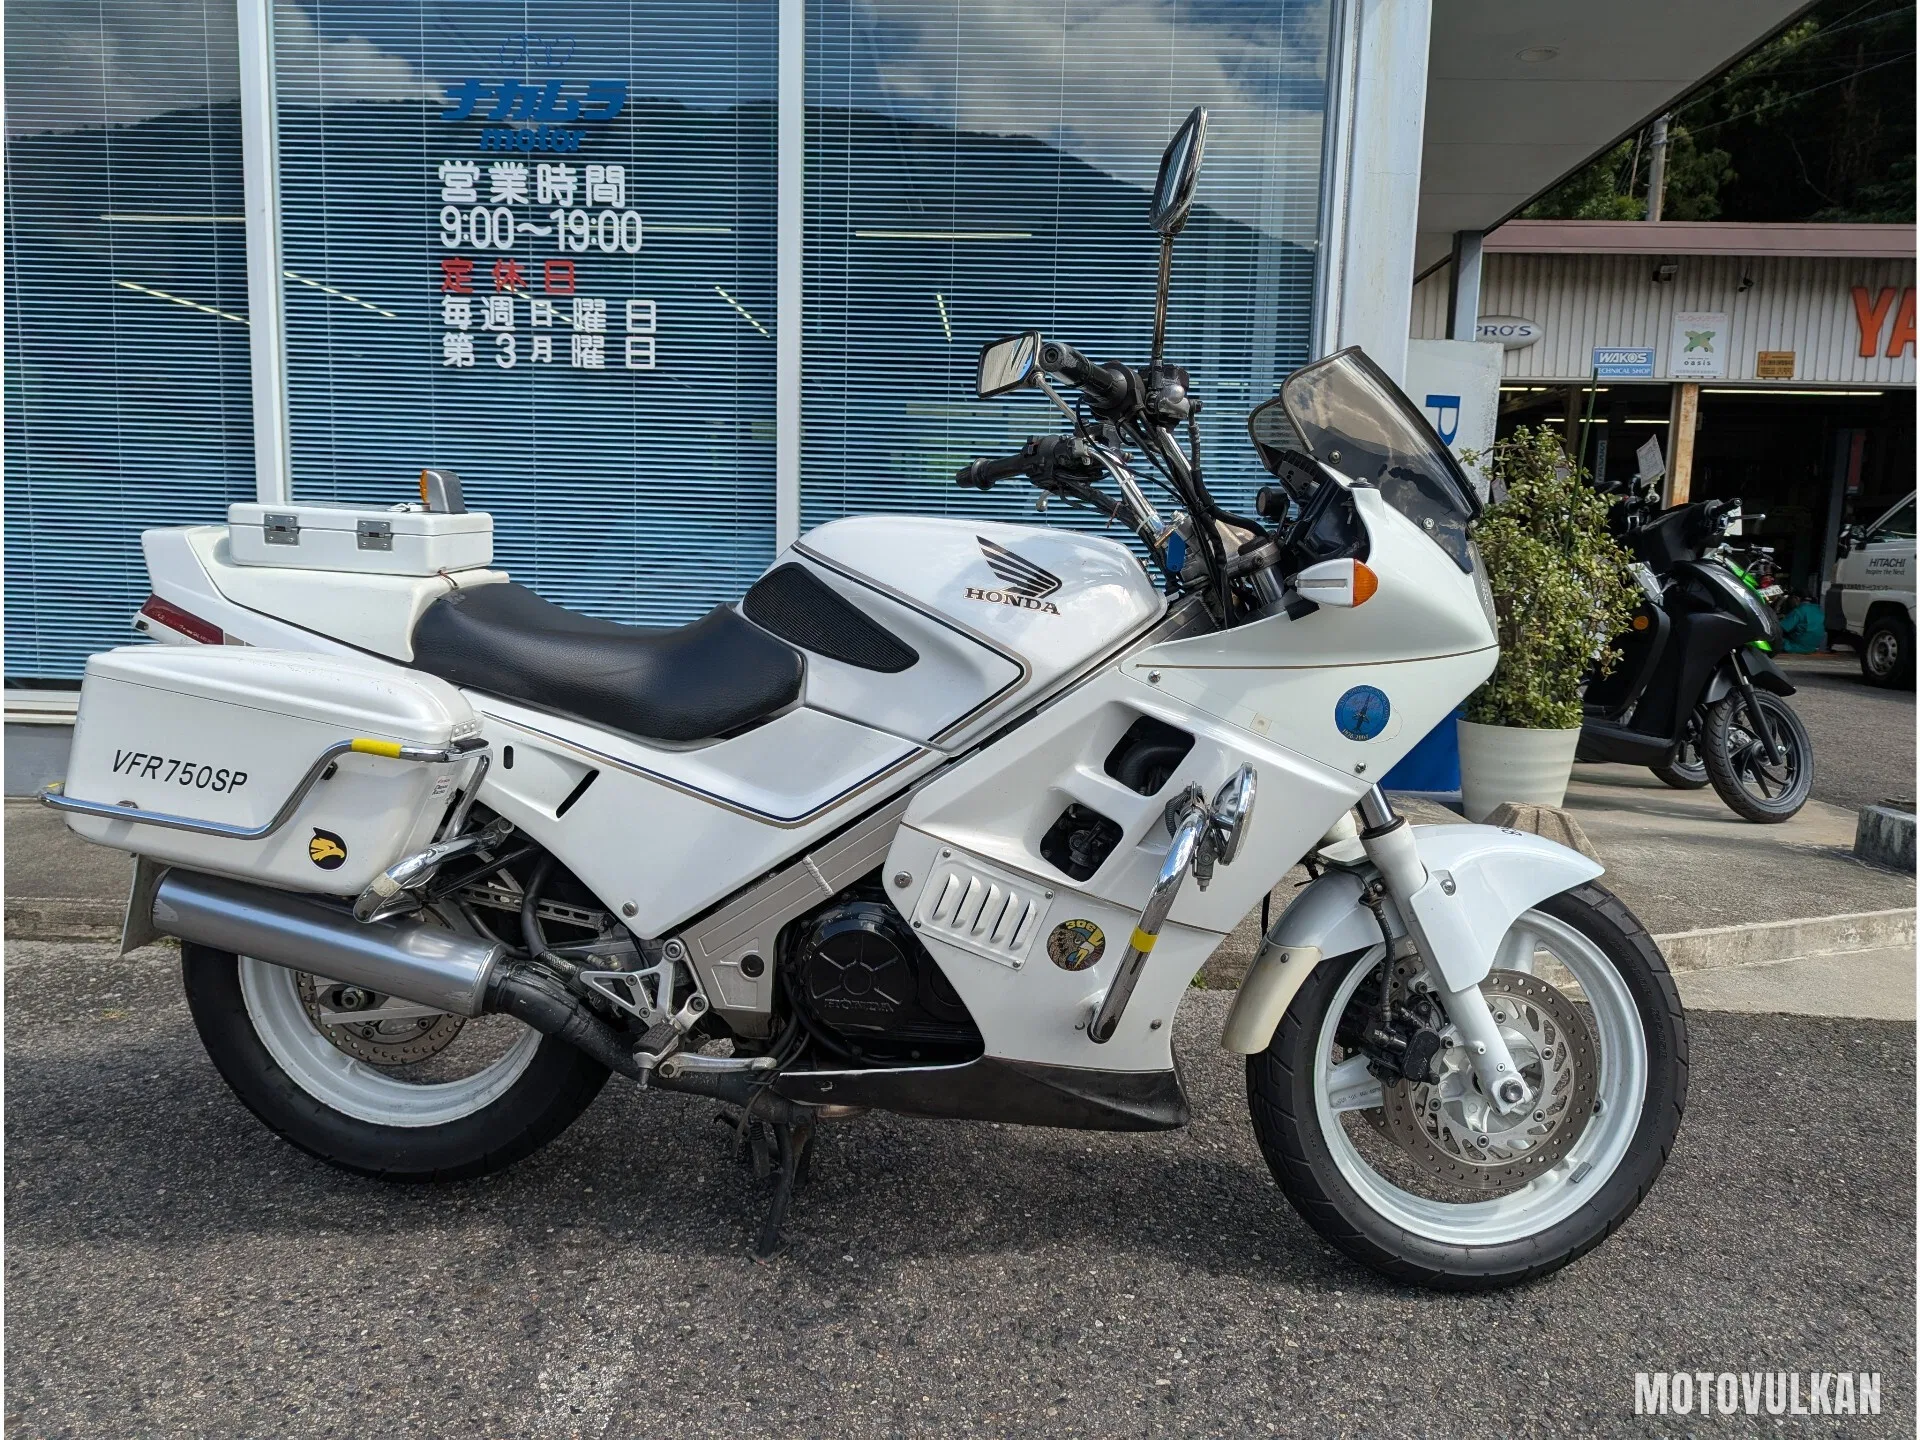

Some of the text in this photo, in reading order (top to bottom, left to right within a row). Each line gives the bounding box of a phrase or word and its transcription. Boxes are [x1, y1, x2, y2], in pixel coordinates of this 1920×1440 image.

[440, 79, 628, 120] ナカムラ
[480, 127, 586, 151] motor
[438, 160, 626, 208] 営業時間
[441, 258, 575, 294] 定休日
[1869, 558, 1907, 568] HITACHI
[964, 587, 1061, 615] HONDA
[112, 749, 249, 794] VFR750SP
[1065, 919, 1097, 932] 306
[824, 998, 895, 1013] HONDA
